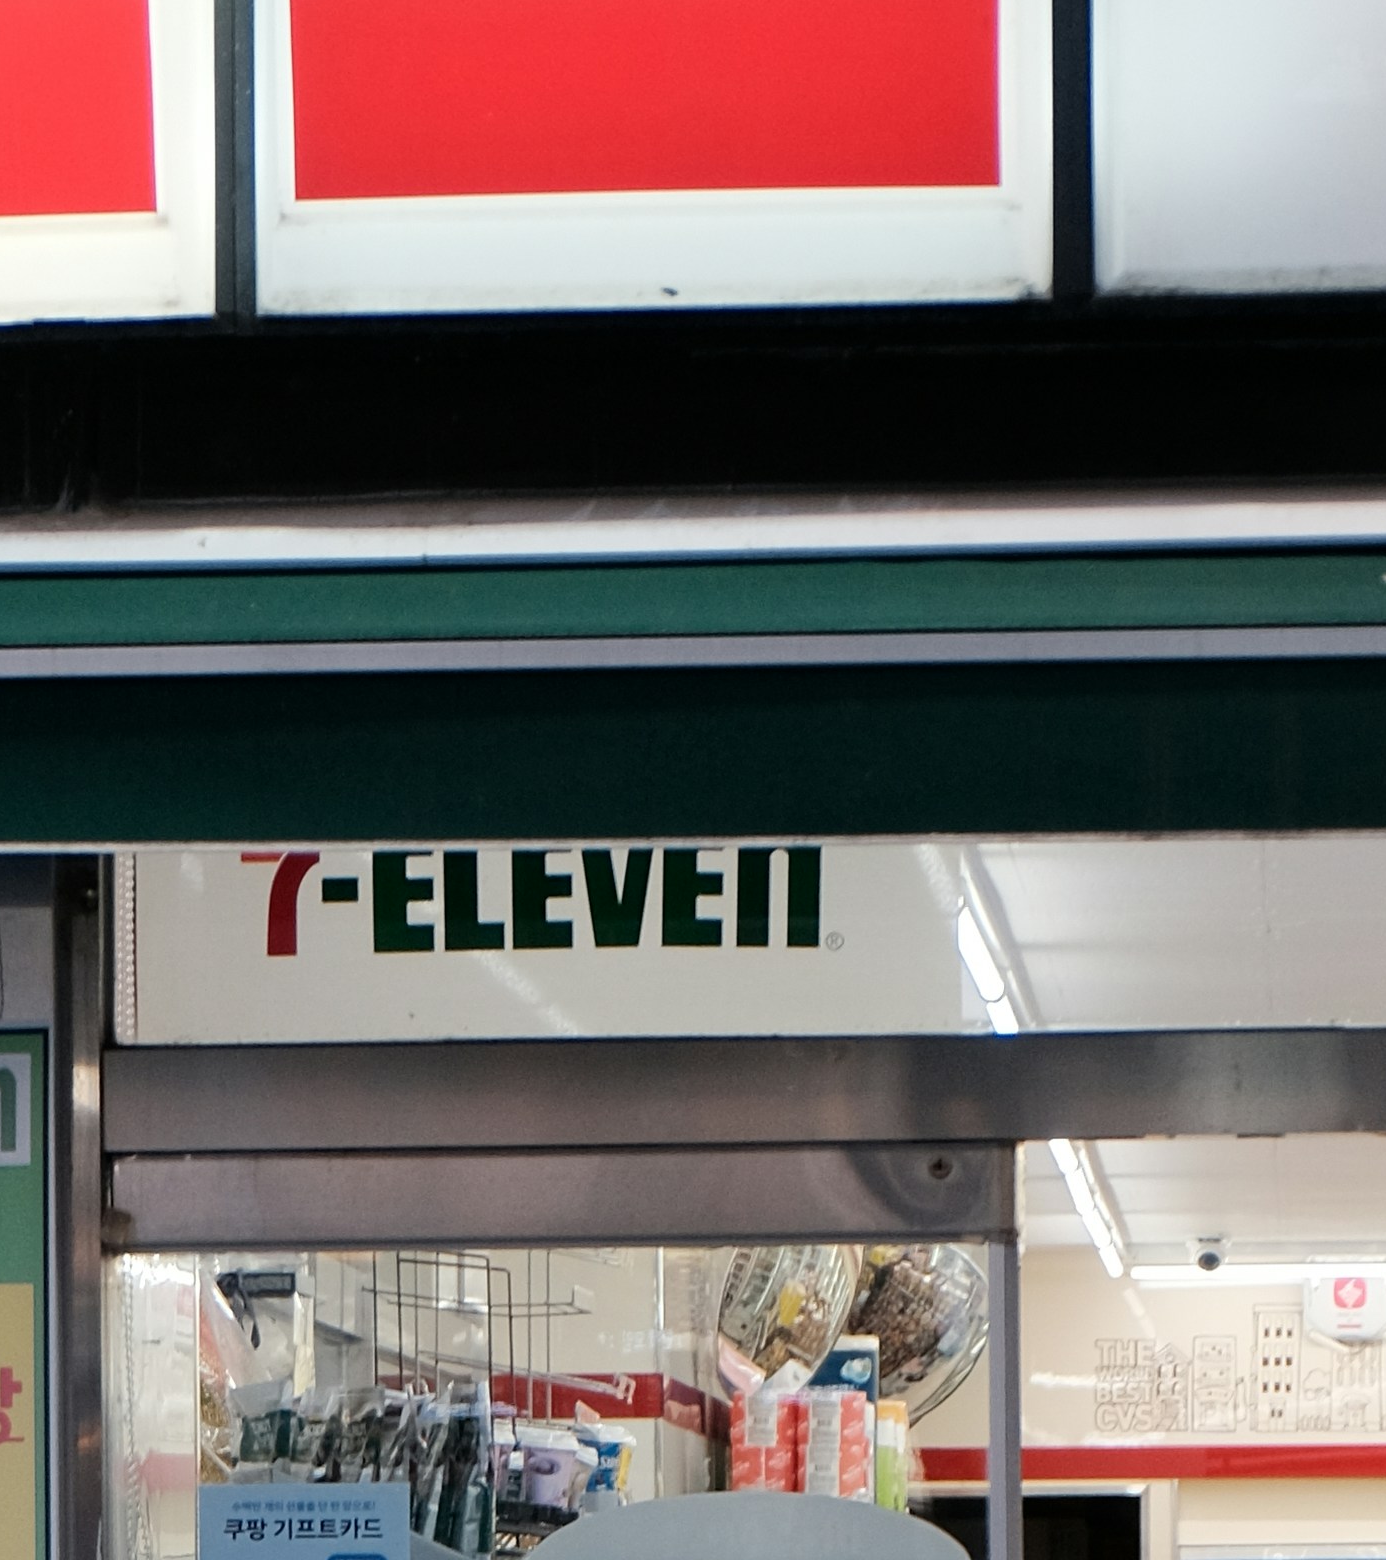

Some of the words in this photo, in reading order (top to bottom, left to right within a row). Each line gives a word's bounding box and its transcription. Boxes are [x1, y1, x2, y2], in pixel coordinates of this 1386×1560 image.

[1094, 1337, 1156, 1369] THE
[1094, 1381, 1154, 1403] BEST
[1094, 1402, 1154, 1433] CVS
[223, 1517, 268, 1541] 쿠팡
[273, 1517, 384, 1541] 기프트카드
